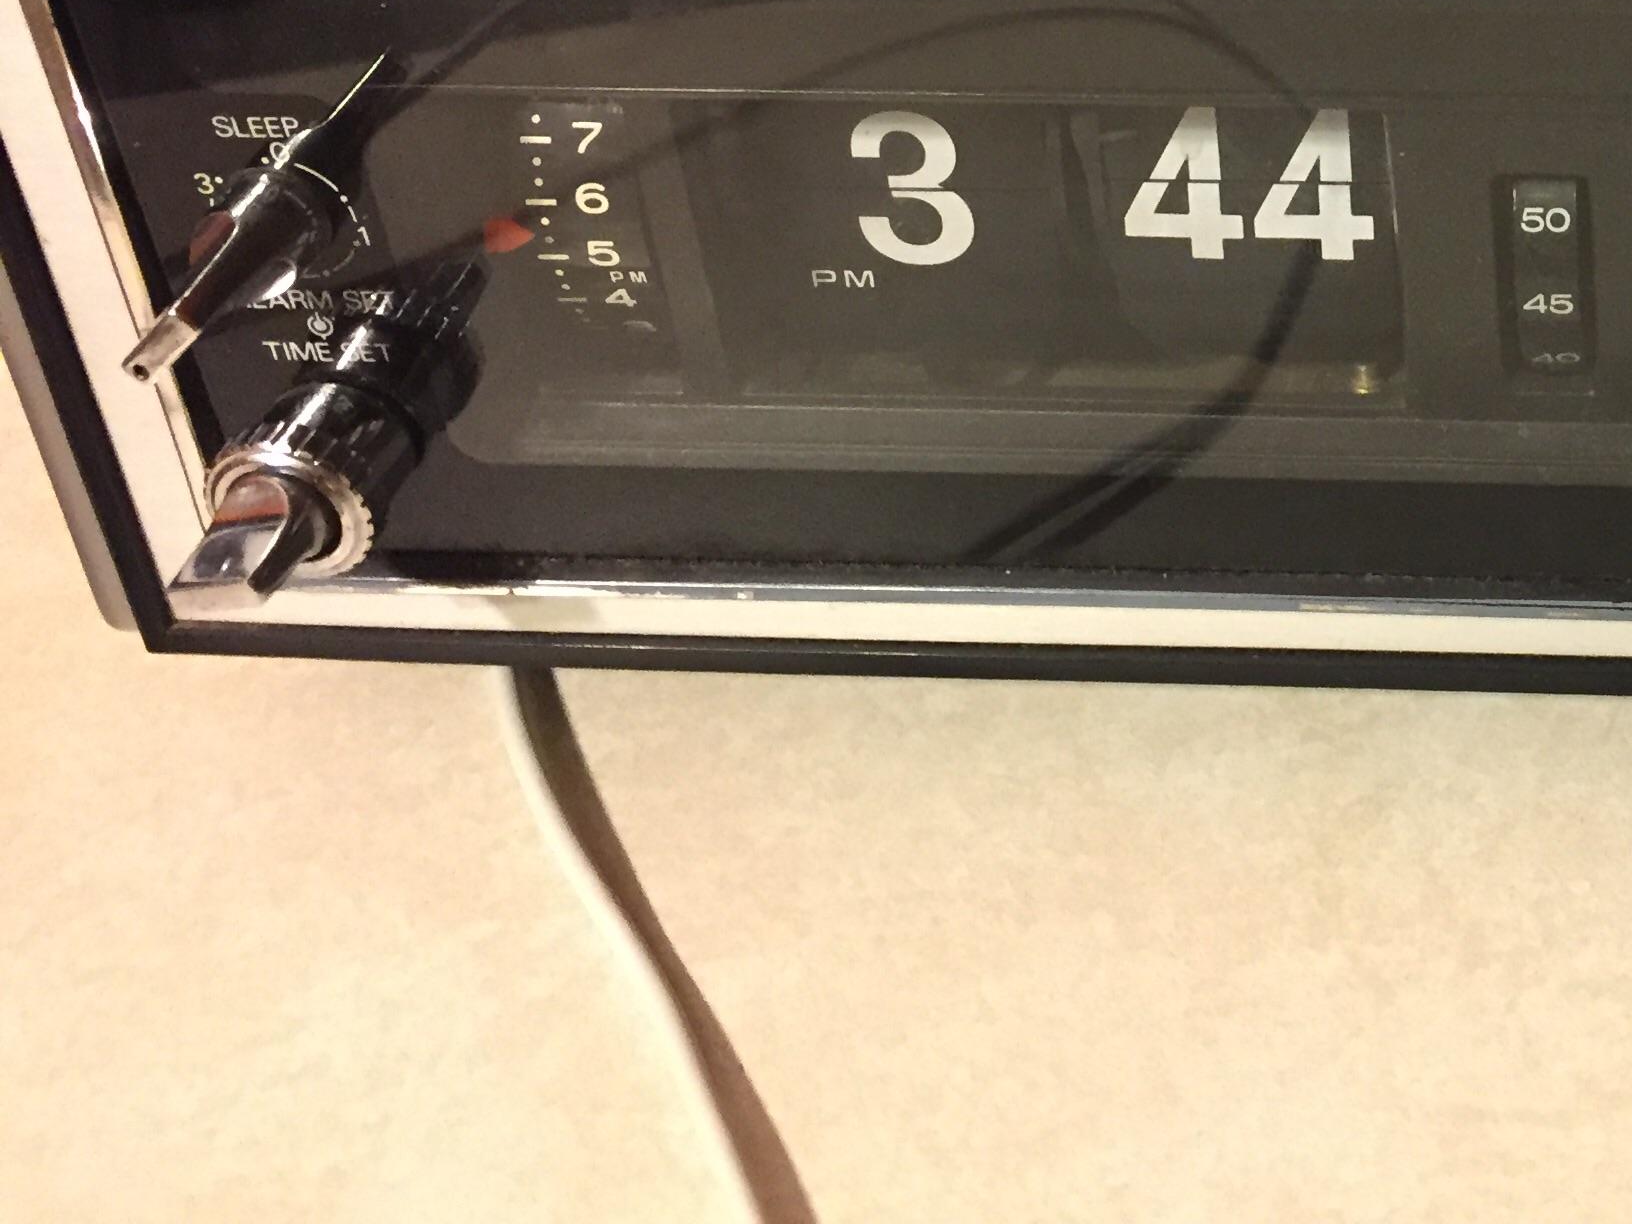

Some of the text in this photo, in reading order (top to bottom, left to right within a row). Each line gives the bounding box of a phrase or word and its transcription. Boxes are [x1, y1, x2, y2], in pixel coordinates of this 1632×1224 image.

[211, 116, 299, 138] SLEEP
[571, 121, 603, 155] 7
[850, 110, 975, 266] 3
[1124, 106, 1375, 261] 44
[574, 182, 610, 215] 6
[1520, 207, 1571, 233] 50
[587, 240, 621, 267] 5
[609, 270, 648, 284] PM
[811, 270, 876, 289] PM
[605, 288, 638, 307] 4
[1522, 293, 1575, 315] 45
[262, 341, 334, 362] TIME
